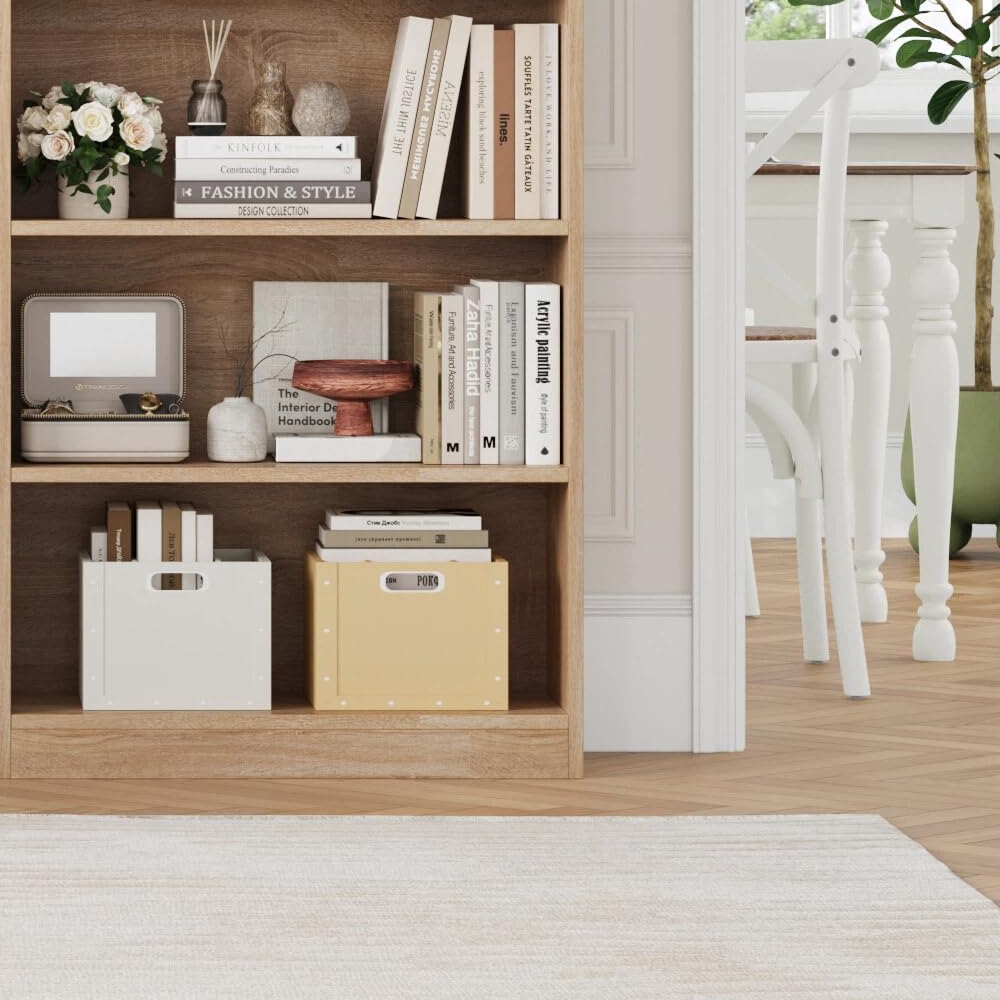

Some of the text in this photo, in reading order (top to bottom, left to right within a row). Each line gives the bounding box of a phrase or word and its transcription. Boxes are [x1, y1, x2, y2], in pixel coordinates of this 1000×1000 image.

[524, 56, 533, 96] SOUFFLÉS
[477, 71, 486, 109] exploring
[499, 113, 510, 146] lines.
[228, 143, 281, 152] KINFOLK
[220, 165, 267, 175] Constructing
[524, 154, 533, 193] GÂTEAUX
[201, 186, 356, 199] FASHION & STYLE
[238, 206, 309, 216] DESIGN COLLECTION
[466, 298, 480, 396] Zaha Hadid
[536, 300, 551, 384] Acrylic painting
[448, 344, 456, 354] Art
[448, 355, 456, 369] and
[510, 351, 519, 415] and Fauvism
[278, 389, 299, 398] The
[448, 370, 456, 410] Accessories
[278, 403, 320, 412] Interior
[278, 416, 336, 426] Handbook
[446, 443, 459, 452] M
[483, 436, 496, 449] M
